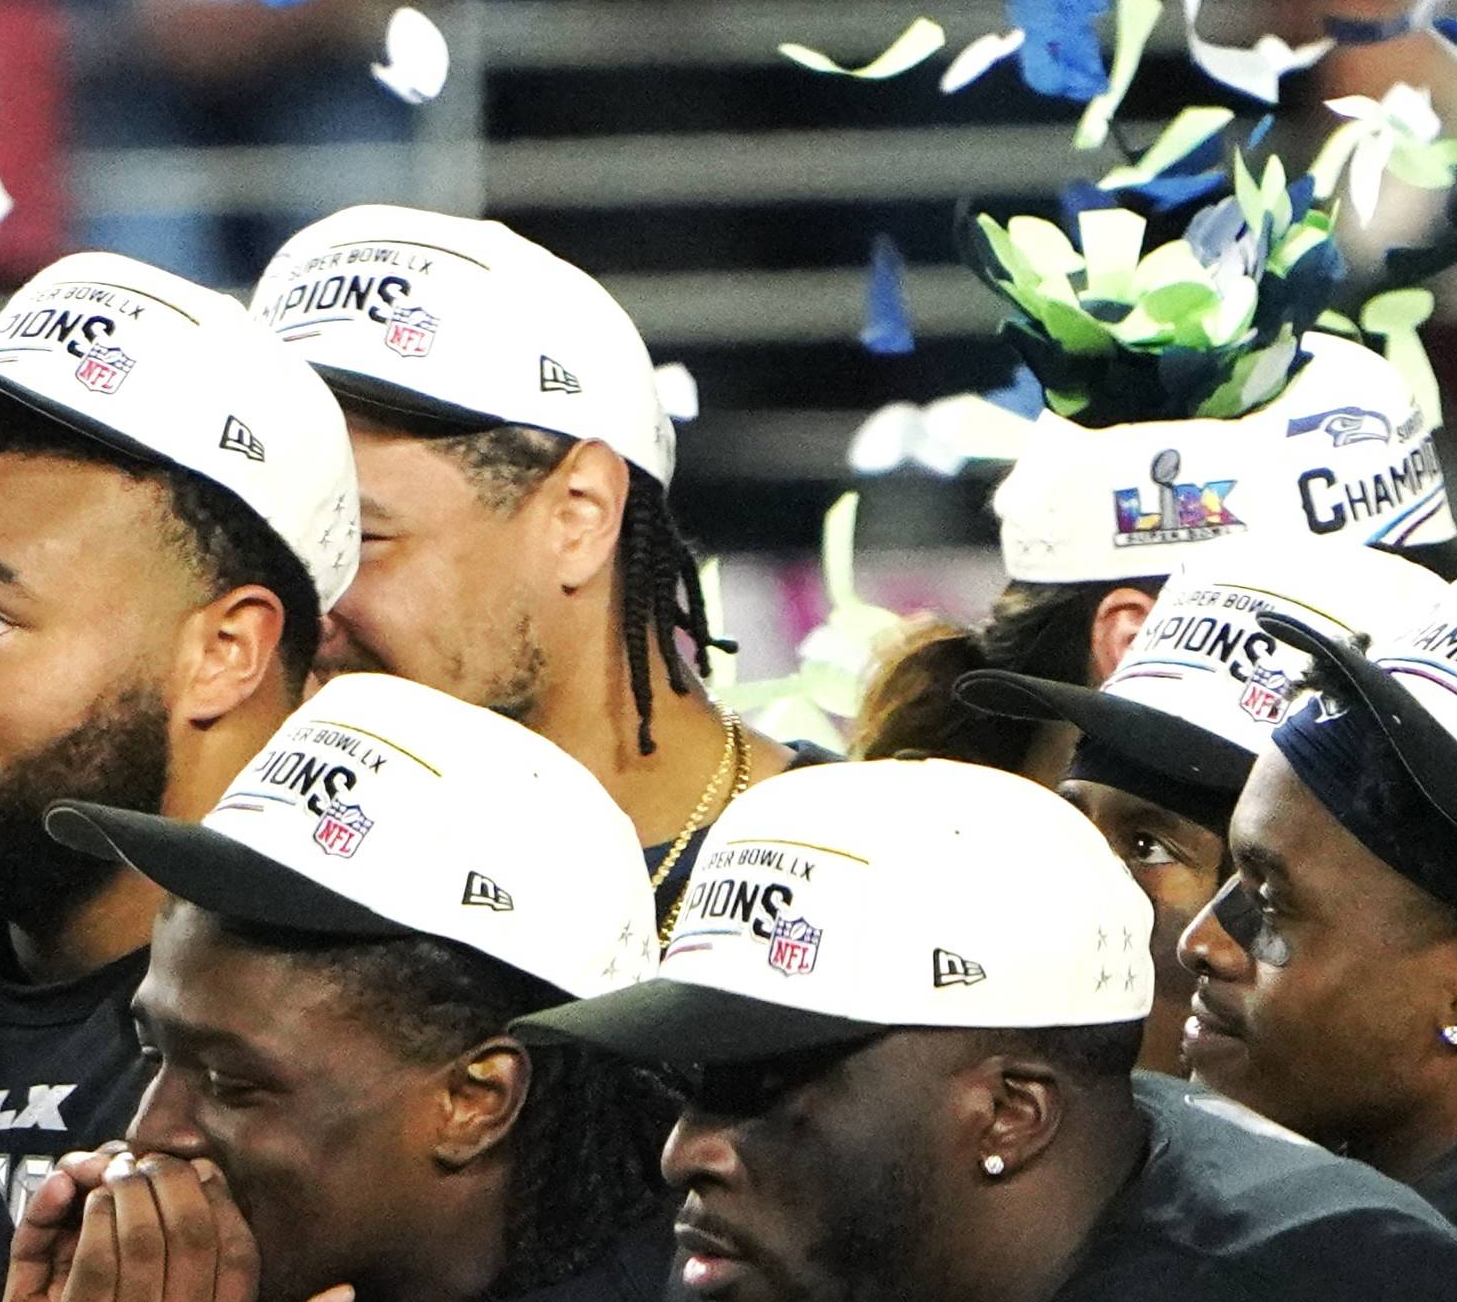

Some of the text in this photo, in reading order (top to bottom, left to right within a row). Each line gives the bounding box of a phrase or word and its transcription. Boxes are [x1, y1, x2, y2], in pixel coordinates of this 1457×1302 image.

[345, 246, 400, 267] BOWL
[408, 257, 434, 275] LX
[62, 285, 116, 308] BOWL
[118, 300, 146, 321] LX
[389, 324, 427, 353] NFL
[79, 359, 118, 391] NFL
[1173, 590, 1276, 614] PER BOW
[312, 728, 359, 758] BOWL
[359, 746, 389, 775] LX
[317, 818, 356, 854] NFL
[737, 847, 786, 872] BOWL
[790, 860, 817, 882] LX
[771, 939, 810, 972] NFL
